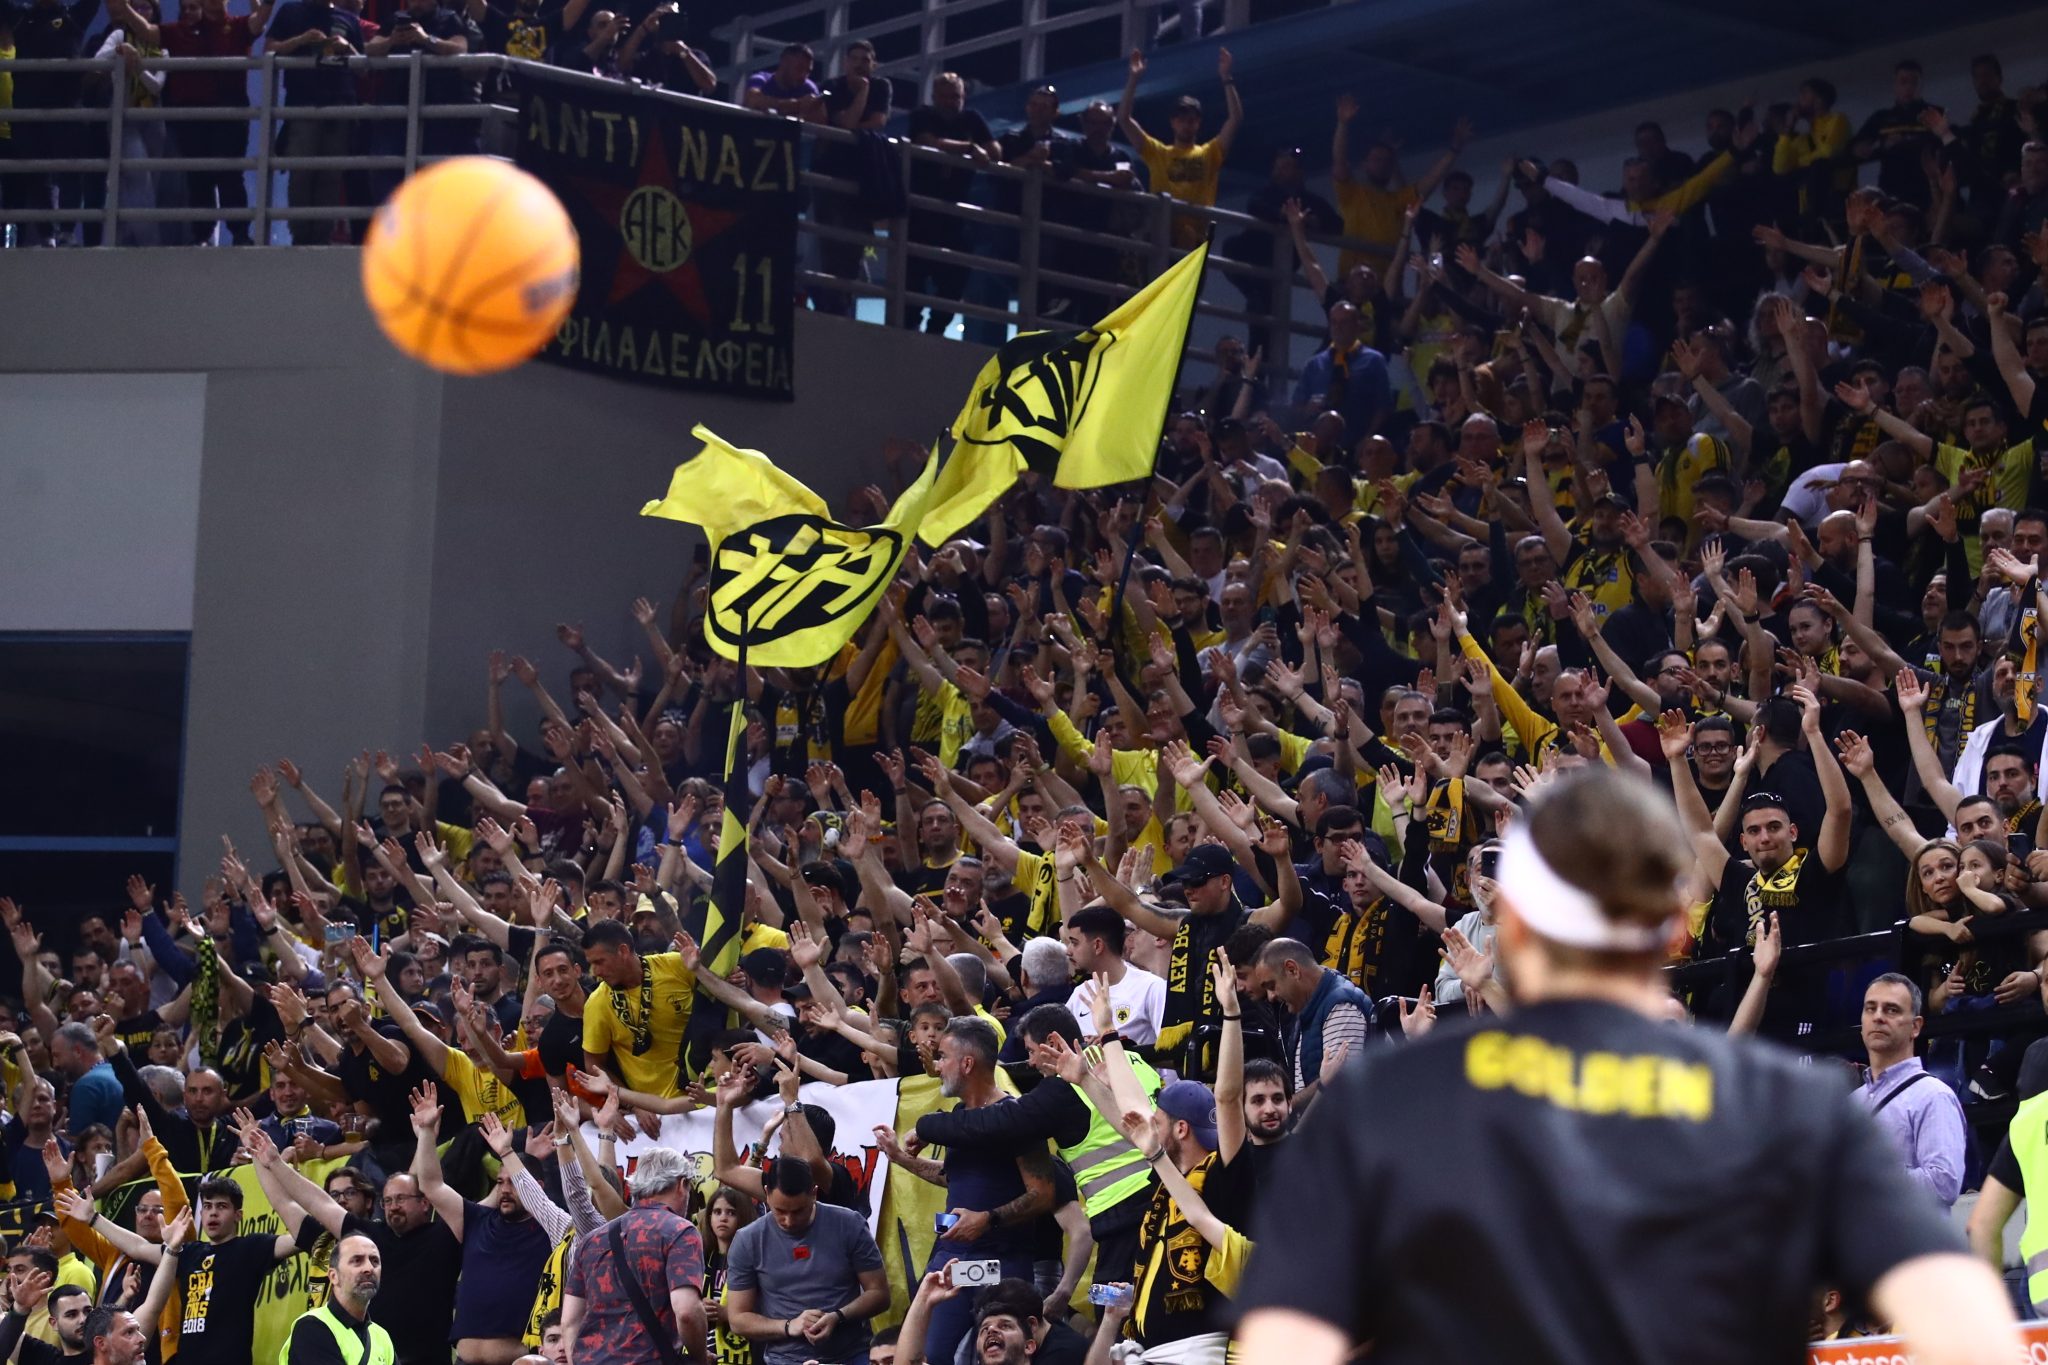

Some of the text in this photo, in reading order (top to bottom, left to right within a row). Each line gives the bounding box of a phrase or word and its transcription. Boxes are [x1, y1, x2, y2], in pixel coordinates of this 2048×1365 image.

[528, 95, 796, 193] ANTI NAZI
[729, 252, 776, 335] 11
[1169, 922, 1191, 993] AEK BC
[183, 1318, 206, 1334] 2018
